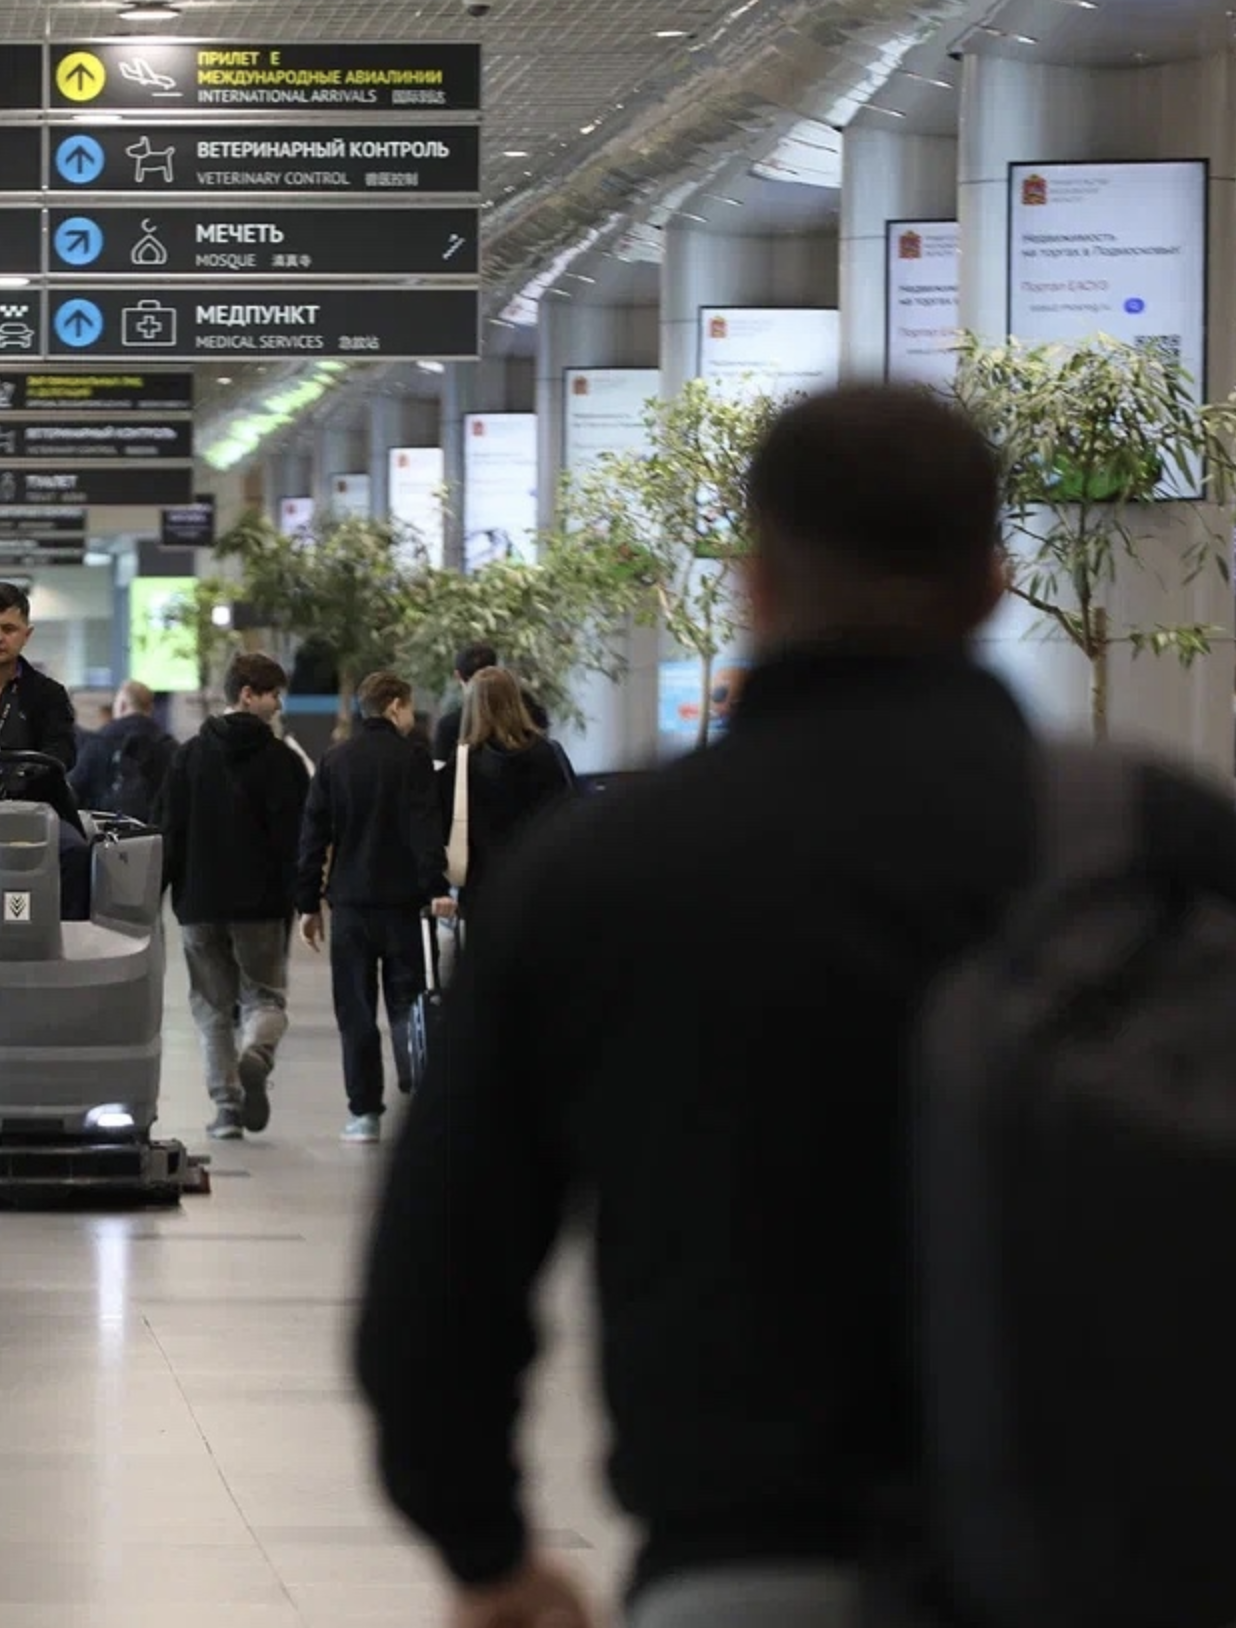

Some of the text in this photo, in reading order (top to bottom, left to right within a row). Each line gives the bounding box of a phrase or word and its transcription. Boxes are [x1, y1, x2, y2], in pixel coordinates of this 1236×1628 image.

[197, 52, 260, 66] ПРИЛЕТ
[197, 70, 443, 86] МЕЖДУНАРОДНЫЕ АВИАЛИНИИ
[197, 89, 377, 103] INTERNATIONAL ARRIVALS
[197, 138, 450, 158] ВЕТЕРИНАРНЫЙ КОНТРОЛЬ
[197, 171, 350, 185] VETERINARY CONTROL
[196, 224, 284, 244] МЕЧЕТЬ
[196, 254, 257, 269] MOSQUE
[196, 305, 321, 327] МЕДПУНКТ
[196, 335, 324, 349] MEDICAL SERVICES
